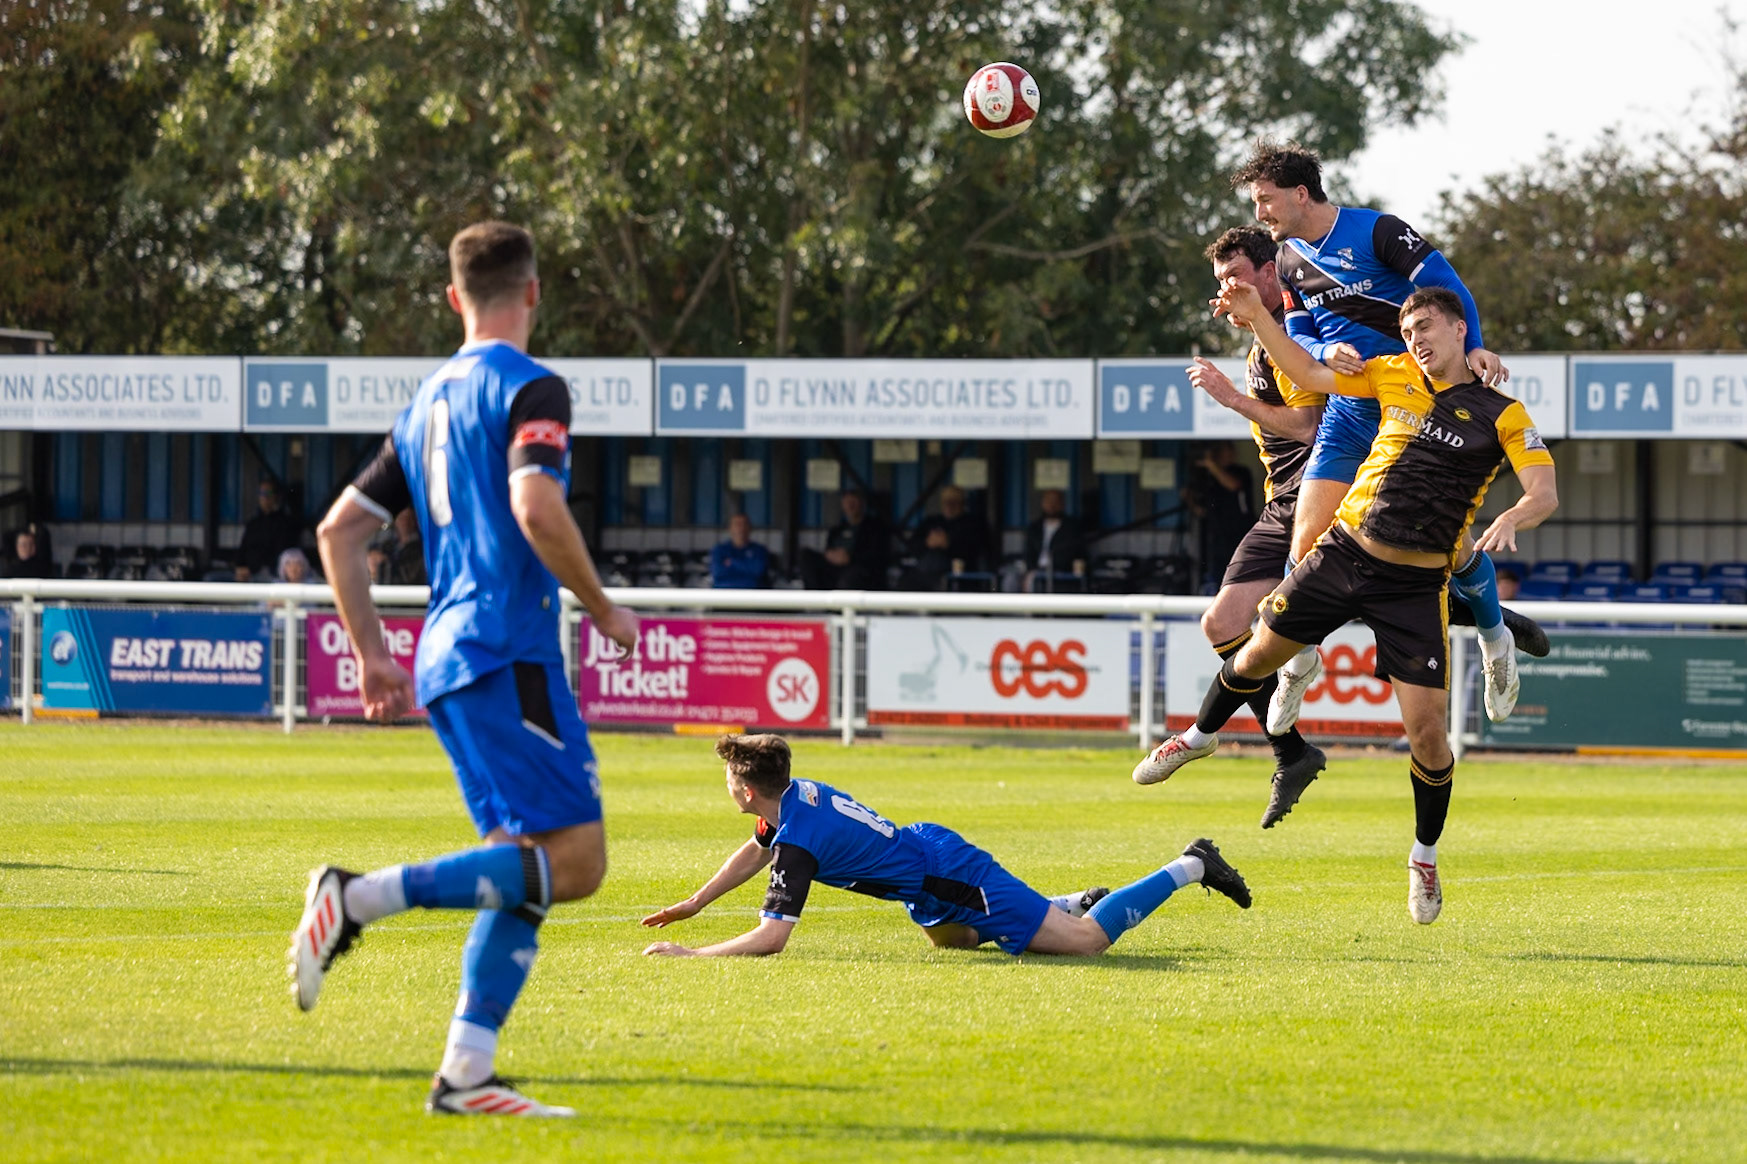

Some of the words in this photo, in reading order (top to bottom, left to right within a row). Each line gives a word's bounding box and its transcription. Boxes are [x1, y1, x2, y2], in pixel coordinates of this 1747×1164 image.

[1325, 278, 1373, 301] TRANS
[0, 374, 35, 402] NN
[42, 374, 175, 403] ASSOCIATES
[183, 374, 229, 404] LTD.
[336, 376, 350, 404] D
[360, 376, 422, 404] FLYN
[590, 377, 639, 406] LTD.
[754, 378, 770, 407] D
[779, 378, 856, 407] FLYNN
[867, 378, 1018, 409] ASSOCIATES
[1026, 378, 1080, 410] LTD.
[1508, 376, 1551, 407] TD.
[1684, 376, 1701, 406] D
[1388, 405, 1465, 448] MERMAID
[110, 637, 176, 668] EAST
[179, 639, 264, 671] TRANS
[646, 624, 697, 662] the
[596, 661, 689, 698] Ticket!
[991, 638, 1088, 698] ces
[776, 673, 810, 704] SK
